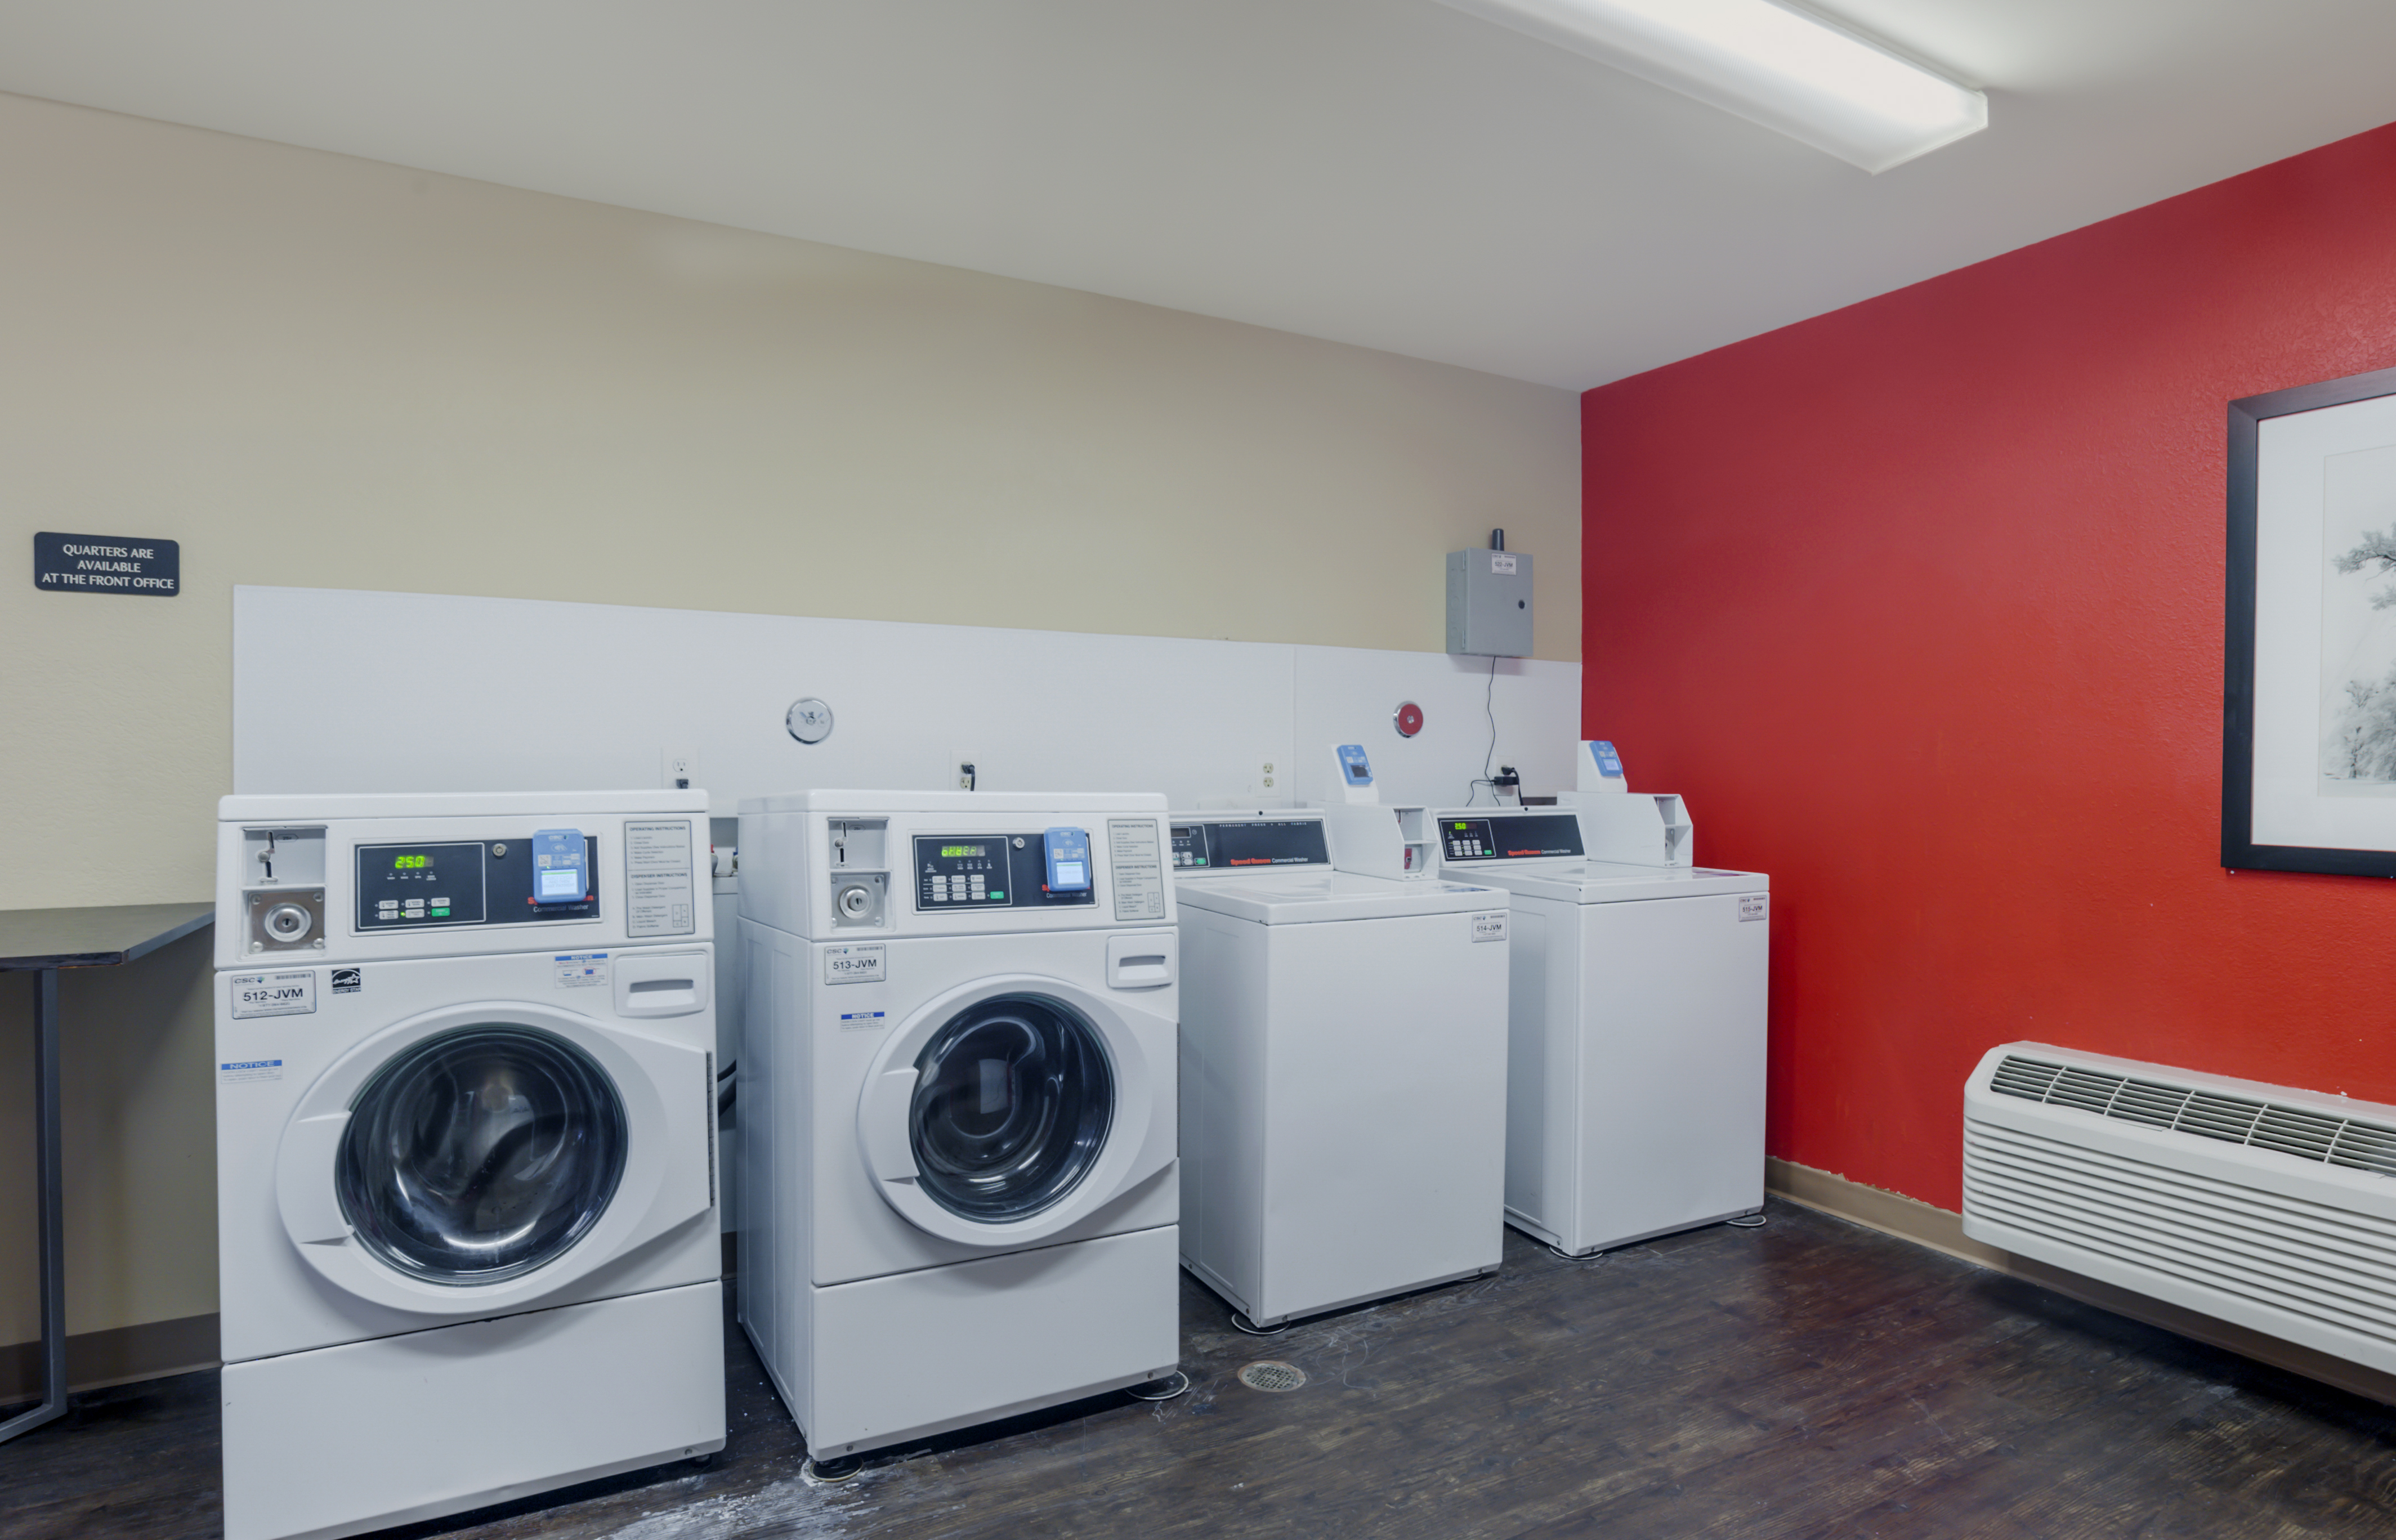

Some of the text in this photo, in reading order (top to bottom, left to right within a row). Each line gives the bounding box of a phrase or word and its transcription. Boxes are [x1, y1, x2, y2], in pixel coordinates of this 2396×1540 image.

[63, 544, 154, 559] QUARTERS ARE
[77, 560, 141, 572] AVAILABLE
[42, 573, 175, 589] AT THE FRONT OFFICE
[1231, 858, 1251, 866] Speed
[833, 959, 877, 970] 513-JVM
[243, 988, 303, 1001] 512-JVM
[230, 1061, 274, 1069] NOTICE
